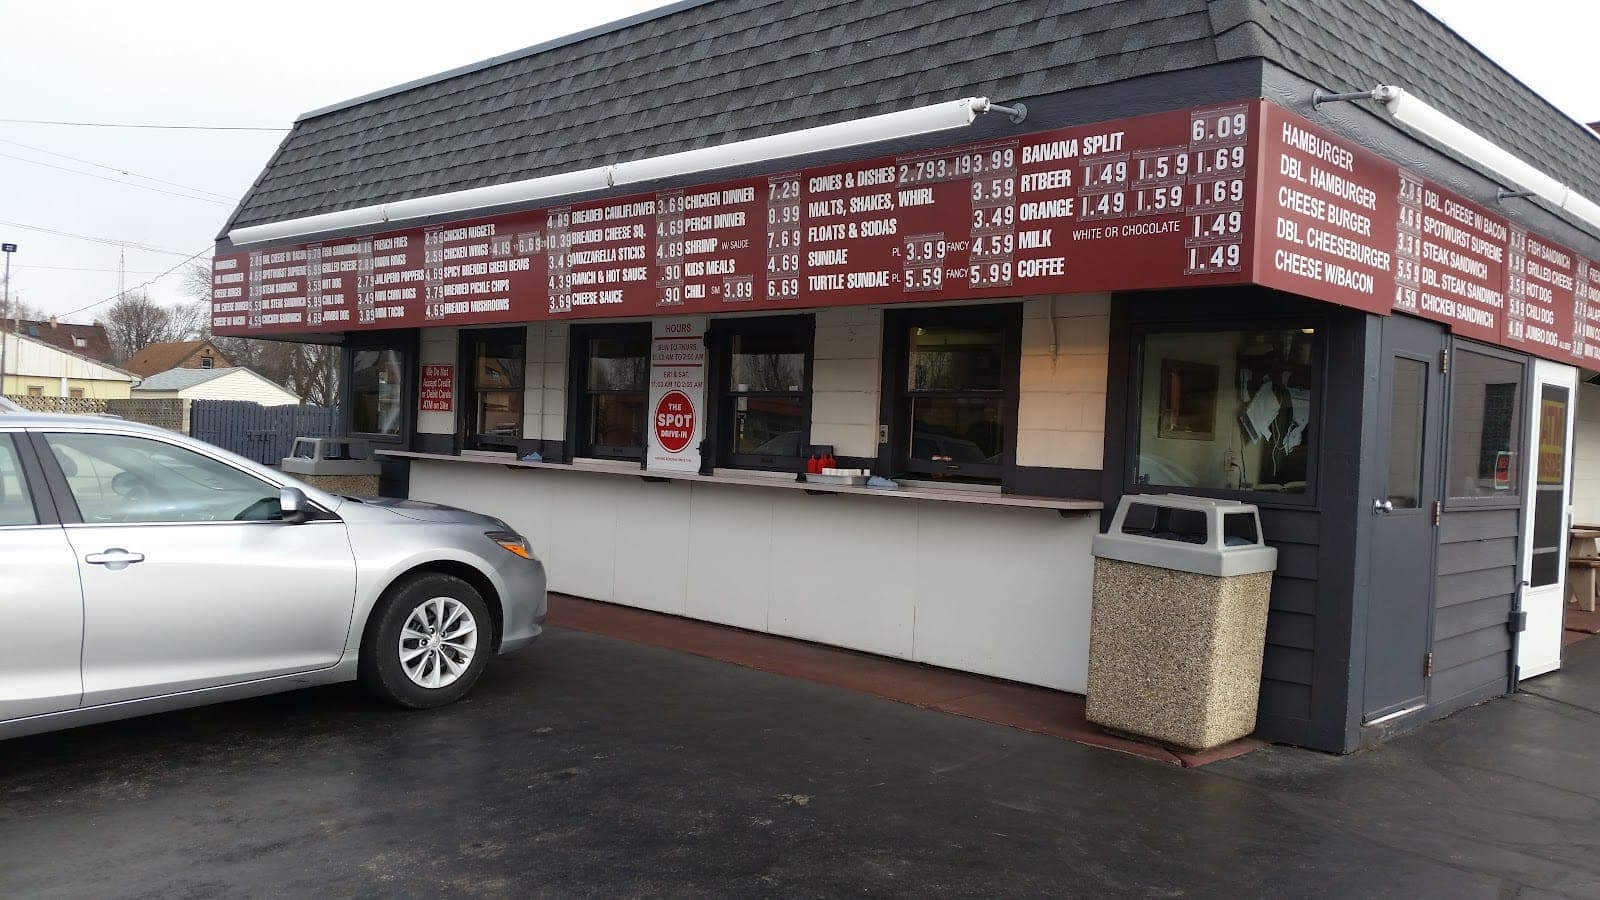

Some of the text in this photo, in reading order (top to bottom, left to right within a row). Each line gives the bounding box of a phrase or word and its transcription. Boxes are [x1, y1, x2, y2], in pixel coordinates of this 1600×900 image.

[1022, 114, 1246, 164] BANANA SPLIT 6.09
[1282, 121, 1354, 172] HAMBURGER
[809, 173, 842, 194] CONES
[845, 172, 855, 188] &
[857, 167, 895, 187] DISHES
[1021, 147, 1244, 193] RTBEER 1.49 1.59 1.69
[685, 181, 799, 210] CHICKEN DINNER 7.29
[808, 178, 1014, 218] MALTS, SHAKES, WHIRL 3.59
[1020, 179, 1243, 221] ORANGE 1.49 1.59 1.69
[1280, 153, 1421, 229] DBL. HAMBURGER 4.69
[572, 197, 684, 224] BREADED CAULIFLOWER 3.69
[685, 205, 800, 232] PERCH DINNER 8.99
[808, 206, 1014, 242] FLOATS & SODAS 3.49
[1279, 186, 1420, 256] CHEESE BURGER 3.39
[1425, 190, 1443, 212] DBL.
[1445, 200, 1473, 225] CHEESE
[1484, 217, 1506, 242] BACON
[444, 227, 467, 241] CHICKEN
[468, 224, 495, 238] NUGGETS
[572, 229, 602, 245] BREADED
[605, 225, 631, 241] CHEESE
[657, 220, 683, 237] 4.69
[685, 238, 718, 254] SHRIMP
[730, 239, 749, 249] SAUCE
[768, 230, 800, 249] 7.69
[1019, 211, 1241, 249] MILK WHITE OR CHOCOLATE 1.49
[1423, 216, 1502, 263] SPOTWURST SUPREME
[444, 246, 467, 260] CHICKEN
[469, 244, 488, 258] WINGS
[571, 249, 616, 265] MOZZARELLA
[618, 246, 645, 260] STICKS
[808, 235, 1014, 266] SUNDAE PL 3.99 FANCY 4.59
[1018, 245, 1240, 277] COFFEE 1.49
[1276, 217, 1419, 282] DBL. CHEESEBURGER 5.59
[1423, 241, 1487, 280] STEAK SANDWICH
[1528, 238, 1570, 269] FISH SANDWICH
[401, 269, 424, 282] POPPERS
[425, 268, 443, 281] 4.69
[444, 266, 460, 278] SPICY
[572, 270, 596, 286] RANCH
[606, 269, 620, 283] HOT
[622, 266, 647, 281] SAUCE
[685, 254, 799, 277] KIDS MEALS 4.69
[808, 262, 1012, 291] TURTLE SUNDAE PL 5.59 FANCY 5.99
[1275, 249, 1417, 308] CHEESE W/BACON 4.59
[1527, 261, 1551, 281] GRILLED
[1552, 271, 1573, 290] CHEESE
[492, 279, 509, 292] CHIPS
[549, 274, 571, 289] 4.39
[685, 284, 705, 299] CHILI
[724, 282, 752, 298] 3.89
[768, 279, 798, 297] 6.69
[1422, 267, 1503, 308] DBL. STEAK SANDWICH
[1527, 282, 1552, 303] HOT DOG
[471, 299, 509, 312] MUSHROOMS
[550, 295, 571, 309] 3.69
[572, 291, 598, 306] CHEESE
[600, 290, 623, 304] SAUCE
[1421, 293, 1493, 328] CHICKEN SANDWICH
[666, 323, 691, 333] HOURS
[1541, 309, 1553, 325] DOG
[1545, 330, 1558, 346] DOG
[658, 413, 692, 428] SPOT
[668, 403, 682, 411] THE
[661, 430, 688, 438] DRIVE-IN
